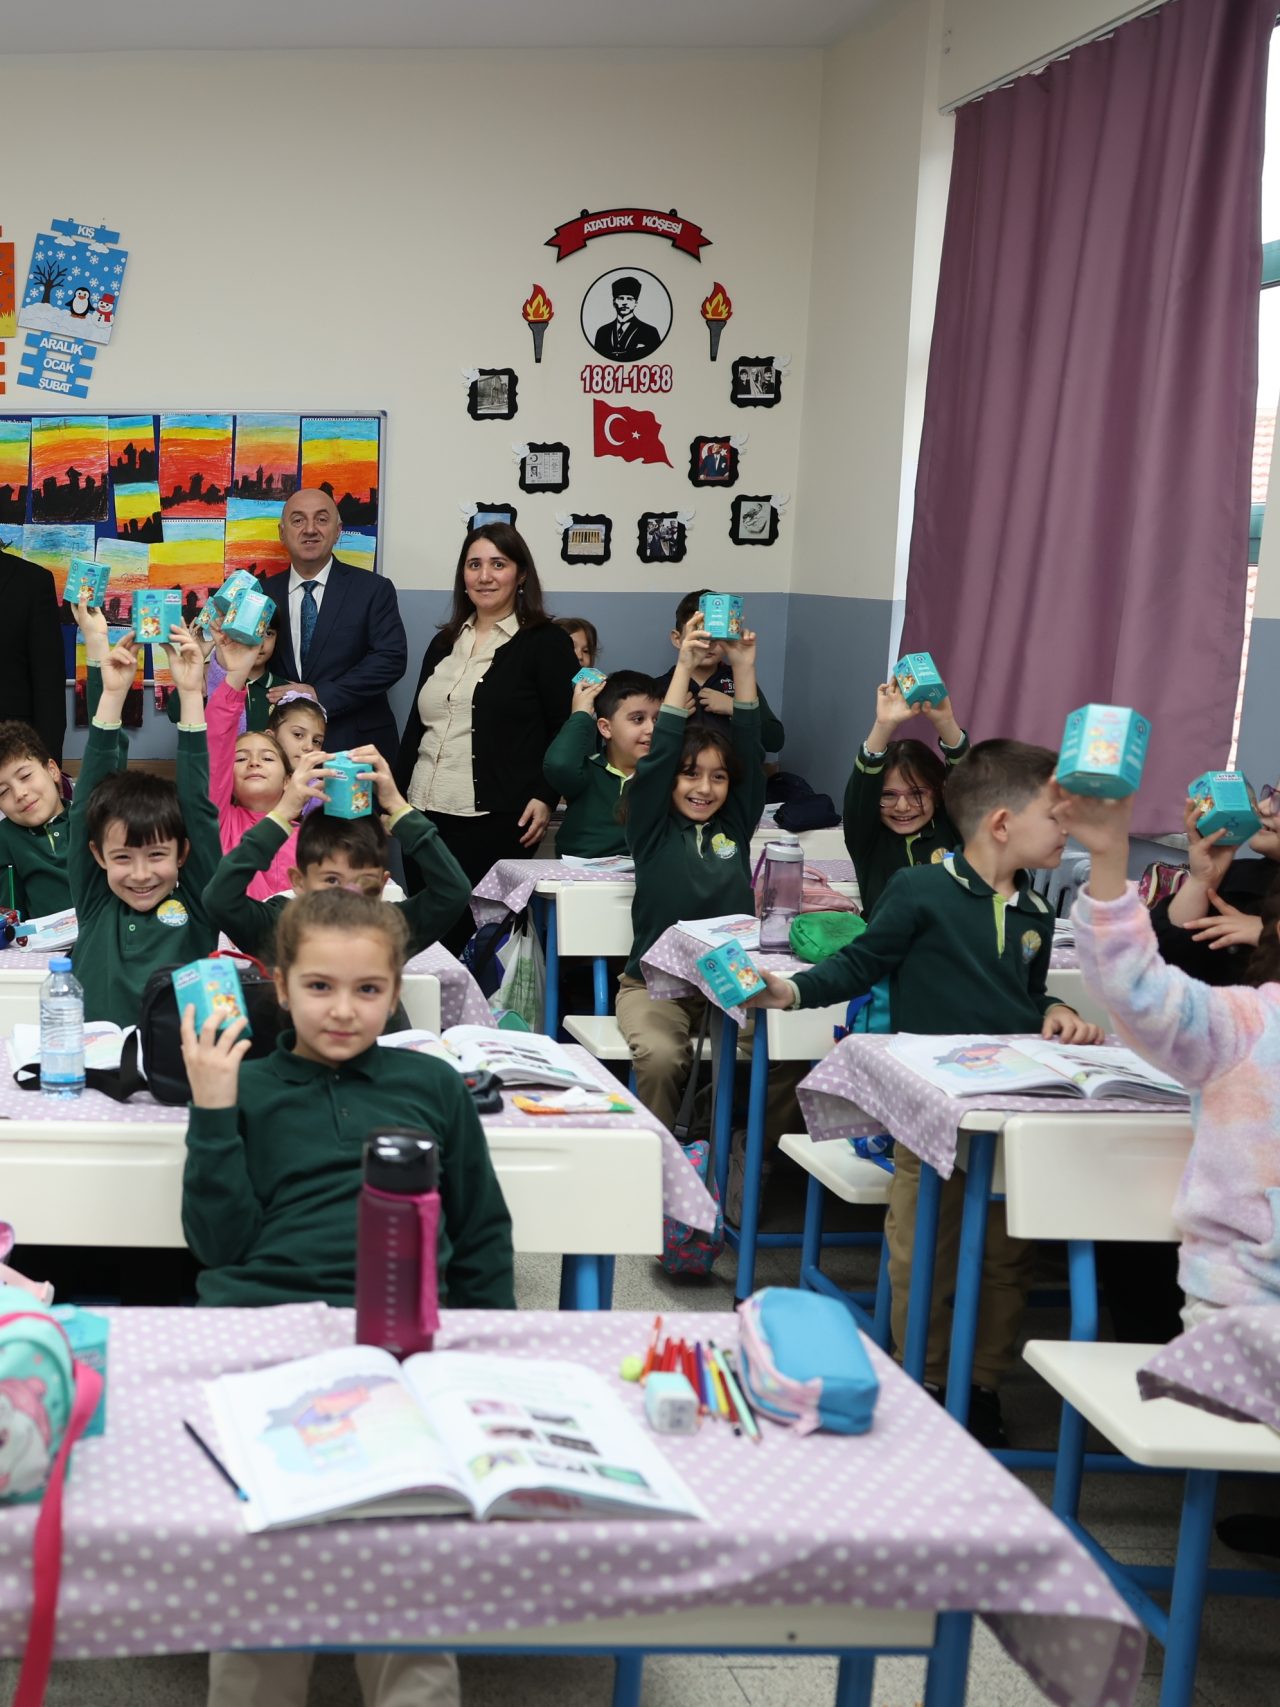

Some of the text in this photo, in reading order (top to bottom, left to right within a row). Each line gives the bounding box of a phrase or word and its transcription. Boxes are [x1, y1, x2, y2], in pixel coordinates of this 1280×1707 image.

[77, 225, 96, 239] KIŞ
[584, 215, 682, 235] ATATÜRK KÖŞESİ
[39, 337, 84, 356] ARALIK
[43, 358, 75, 374] OCAK
[38, 377, 72, 393] ŞUBAT
[581, 364, 673, 393] 1881-1938
